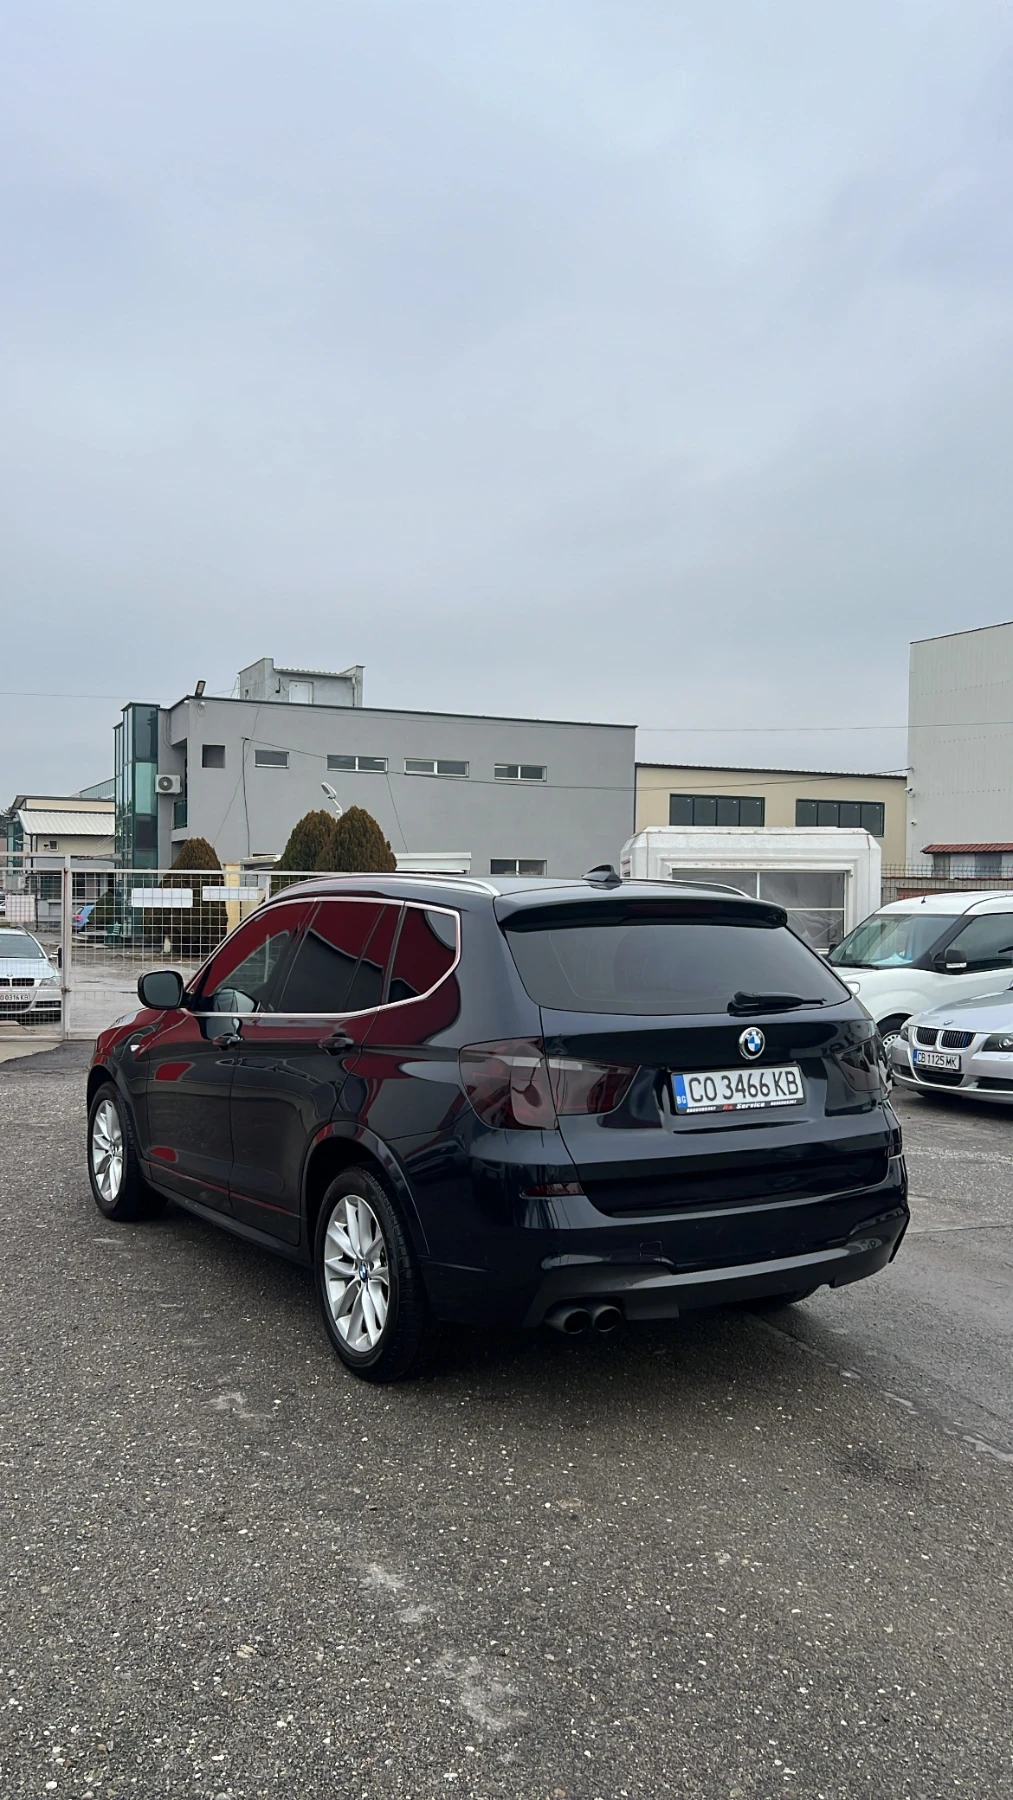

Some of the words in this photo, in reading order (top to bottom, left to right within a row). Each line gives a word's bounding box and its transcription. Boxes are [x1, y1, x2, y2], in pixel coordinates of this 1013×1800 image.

[917, 1052, 926, 1063] CB
[927, 1053, 945, 1066] 1125
[945, 1056, 957, 1068] MK
[688, 1076, 718, 1103] CO
[721, 1073, 771, 1100] 3466
[772, 1071, 799, 1097] KB
[676, 1095, 687, 1104] BG
[735, 1101, 765, 1109] Service
